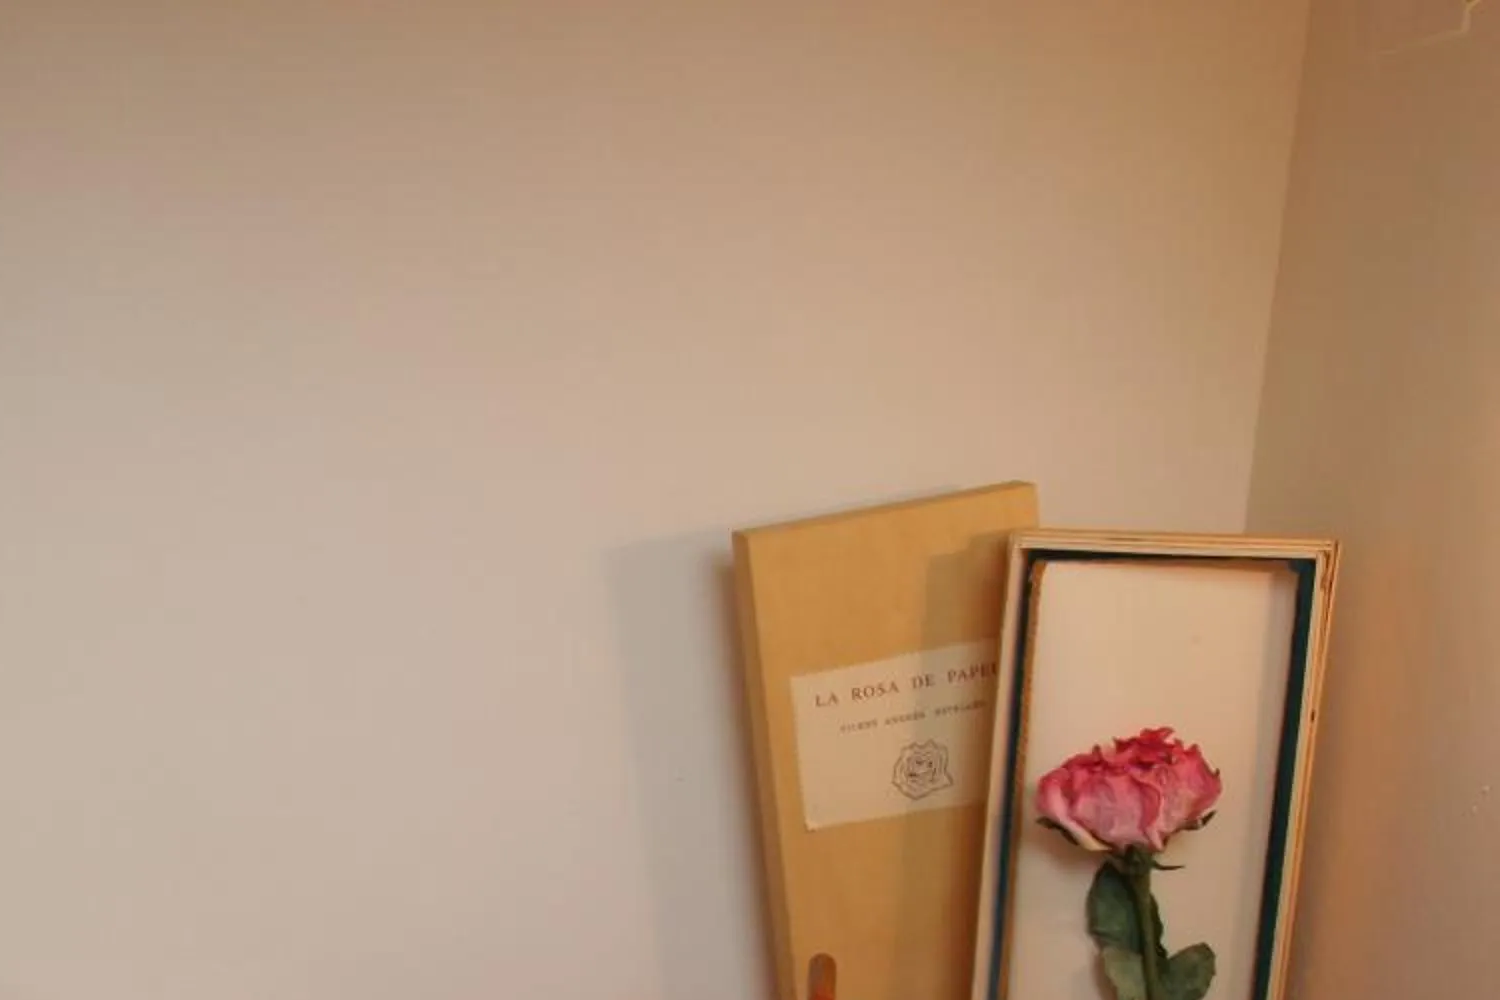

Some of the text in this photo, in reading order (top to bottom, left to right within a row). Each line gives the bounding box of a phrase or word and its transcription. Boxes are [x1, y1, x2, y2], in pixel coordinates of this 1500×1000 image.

[815, 692, 840, 708] LA
[851, 681, 899, 701] ROSA
[912, 673, 936, 690] DE
